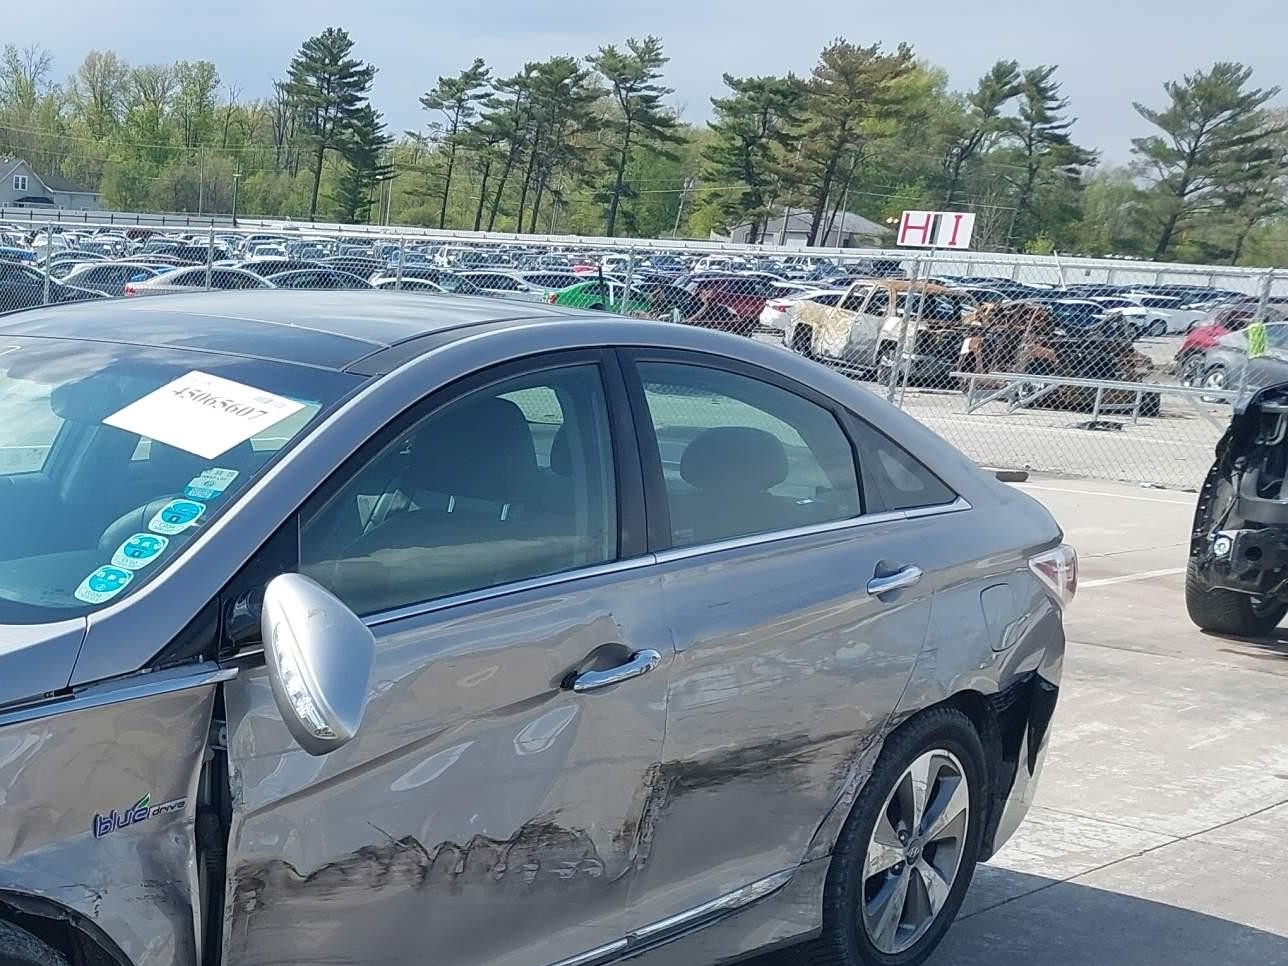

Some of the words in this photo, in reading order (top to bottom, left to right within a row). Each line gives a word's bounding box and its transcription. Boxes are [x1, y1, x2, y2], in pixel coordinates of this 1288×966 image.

[172, 386, 268, 421] 45065607
[93, 803, 151, 839] blue
[152, 801, 186, 817] drive
